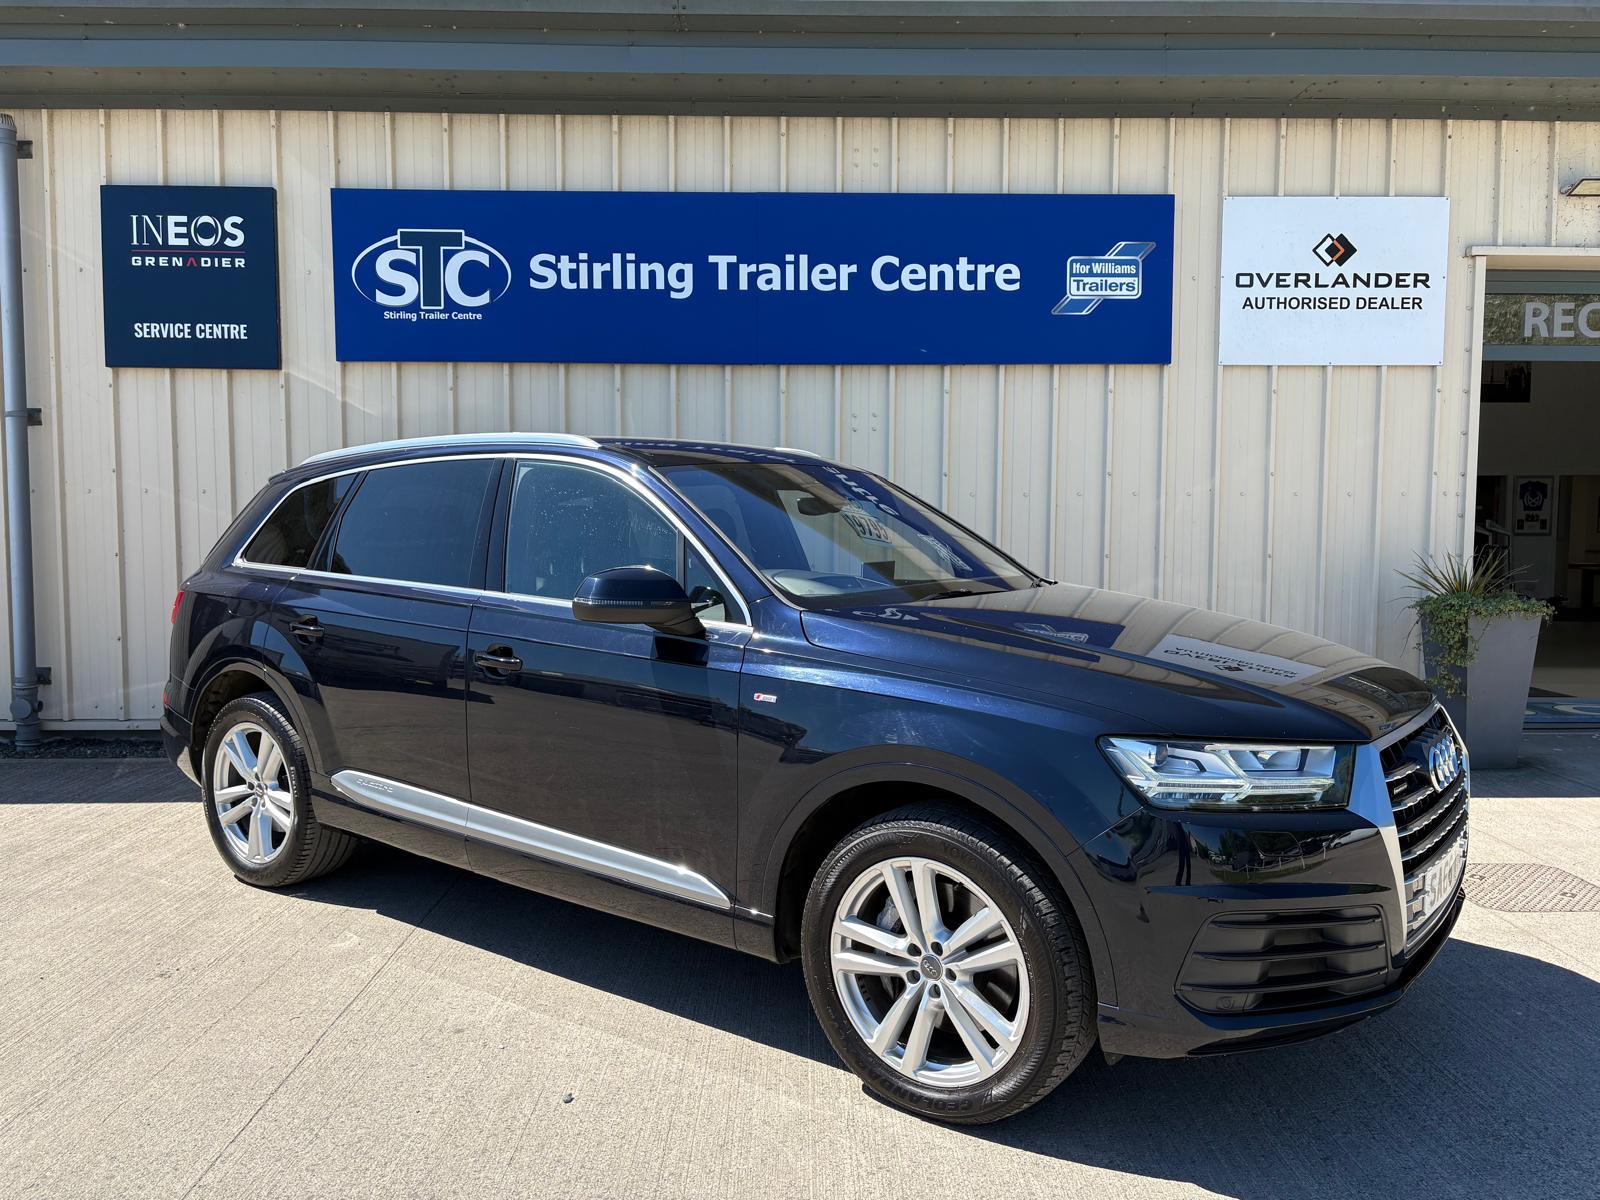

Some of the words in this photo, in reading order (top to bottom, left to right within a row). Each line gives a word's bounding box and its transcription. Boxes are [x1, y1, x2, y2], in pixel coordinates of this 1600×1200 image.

[130, 214, 245, 247] INEOS
[131, 256, 246, 268] GRENADIER
[375, 229, 490, 310] STC
[1072, 262, 1091, 274] Ifor
[1091, 262, 1137, 275] Williams
[529, 252, 694, 300] Stirling
[707, 253, 858, 292] Trailer
[870, 255, 1021, 293] Centre
[1235, 272, 1431, 289] OVERLANDER
[1073, 279, 1136, 292] Trailers
[1242, 296, 1351, 310] AUTHORISED
[1355, 296, 1423, 310] DEALER
[383, 310, 418, 322] Stirling
[418, 311, 450, 320] Trailer
[451, 311, 483, 320] Centre
[1523, 302, 1600, 338] REC
[134, 322, 192, 339] SERVICE
[195, 323, 248, 340] CENTRE
